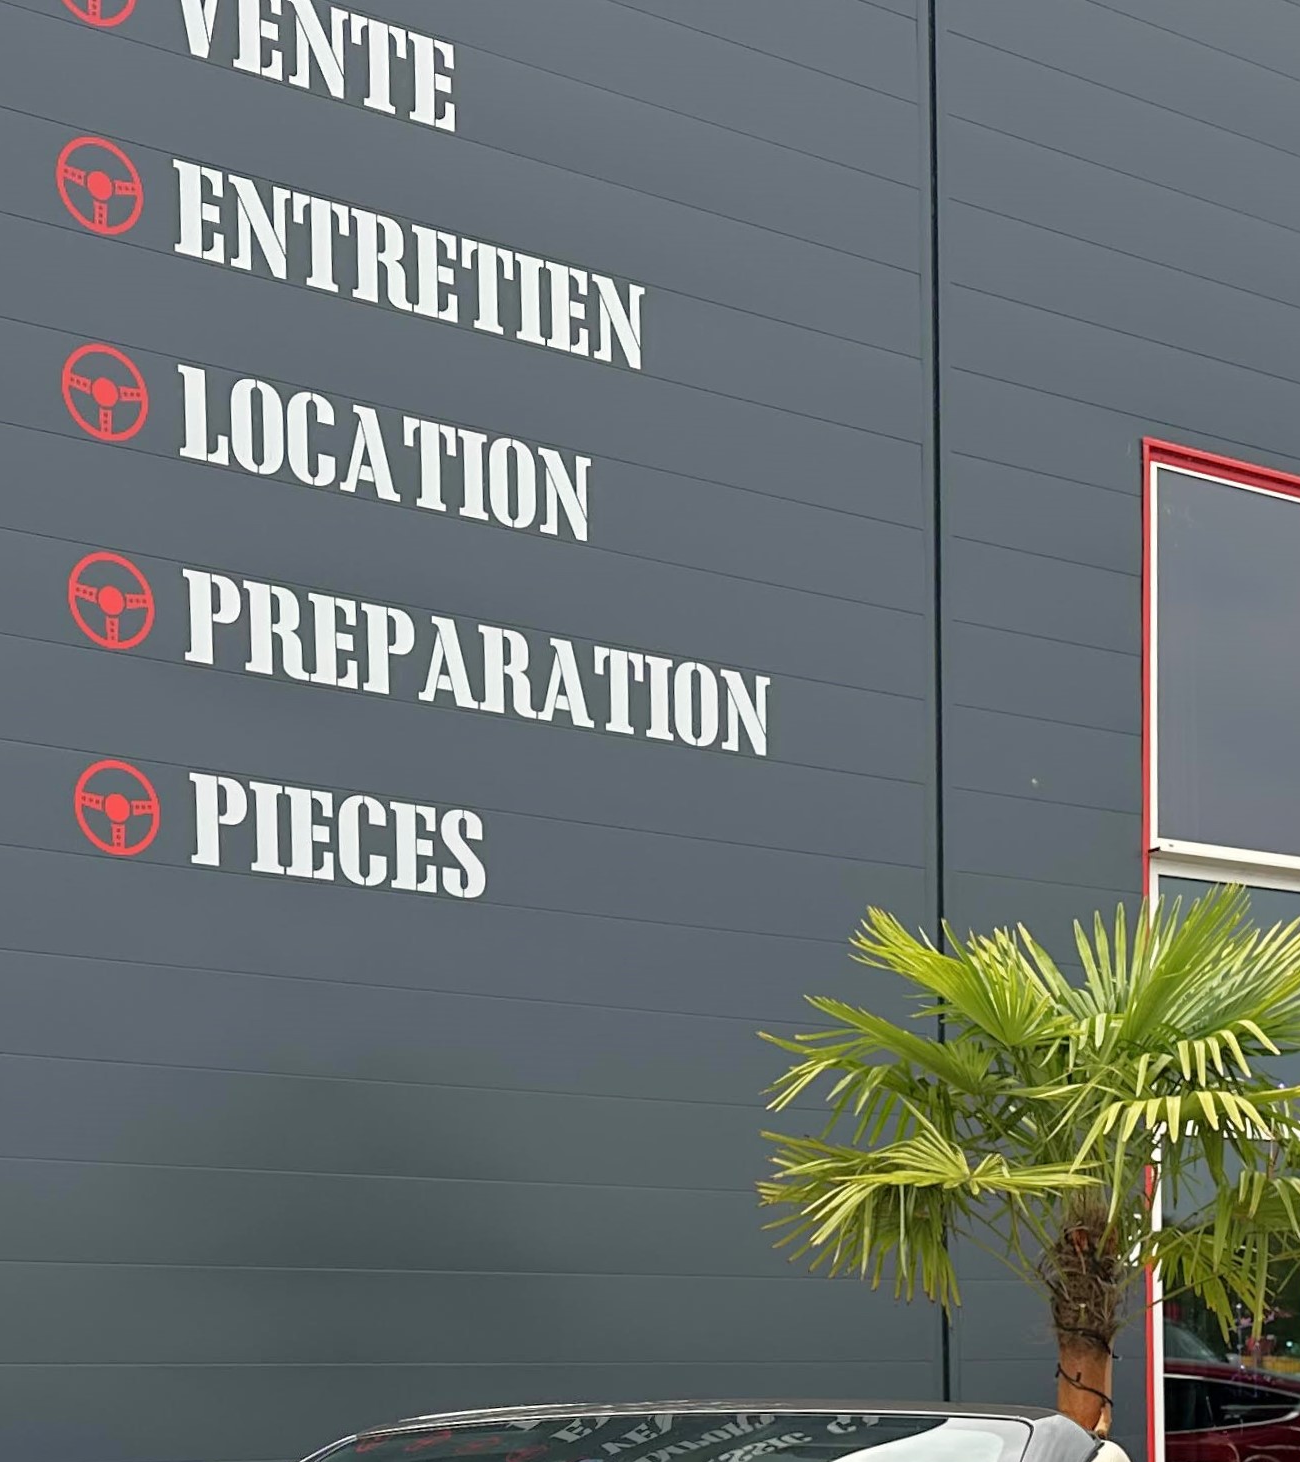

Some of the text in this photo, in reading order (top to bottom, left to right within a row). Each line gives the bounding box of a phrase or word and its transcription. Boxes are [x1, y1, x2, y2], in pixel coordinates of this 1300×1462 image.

[181, 0, 456, 132] VENTE
[173, 158, 645, 370] ENTRETIEN
[177, 364, 592, 542] LOCATION
[183, 568, 771, 757] PREPARATION
[189, 771, 487, 900] PIECES
